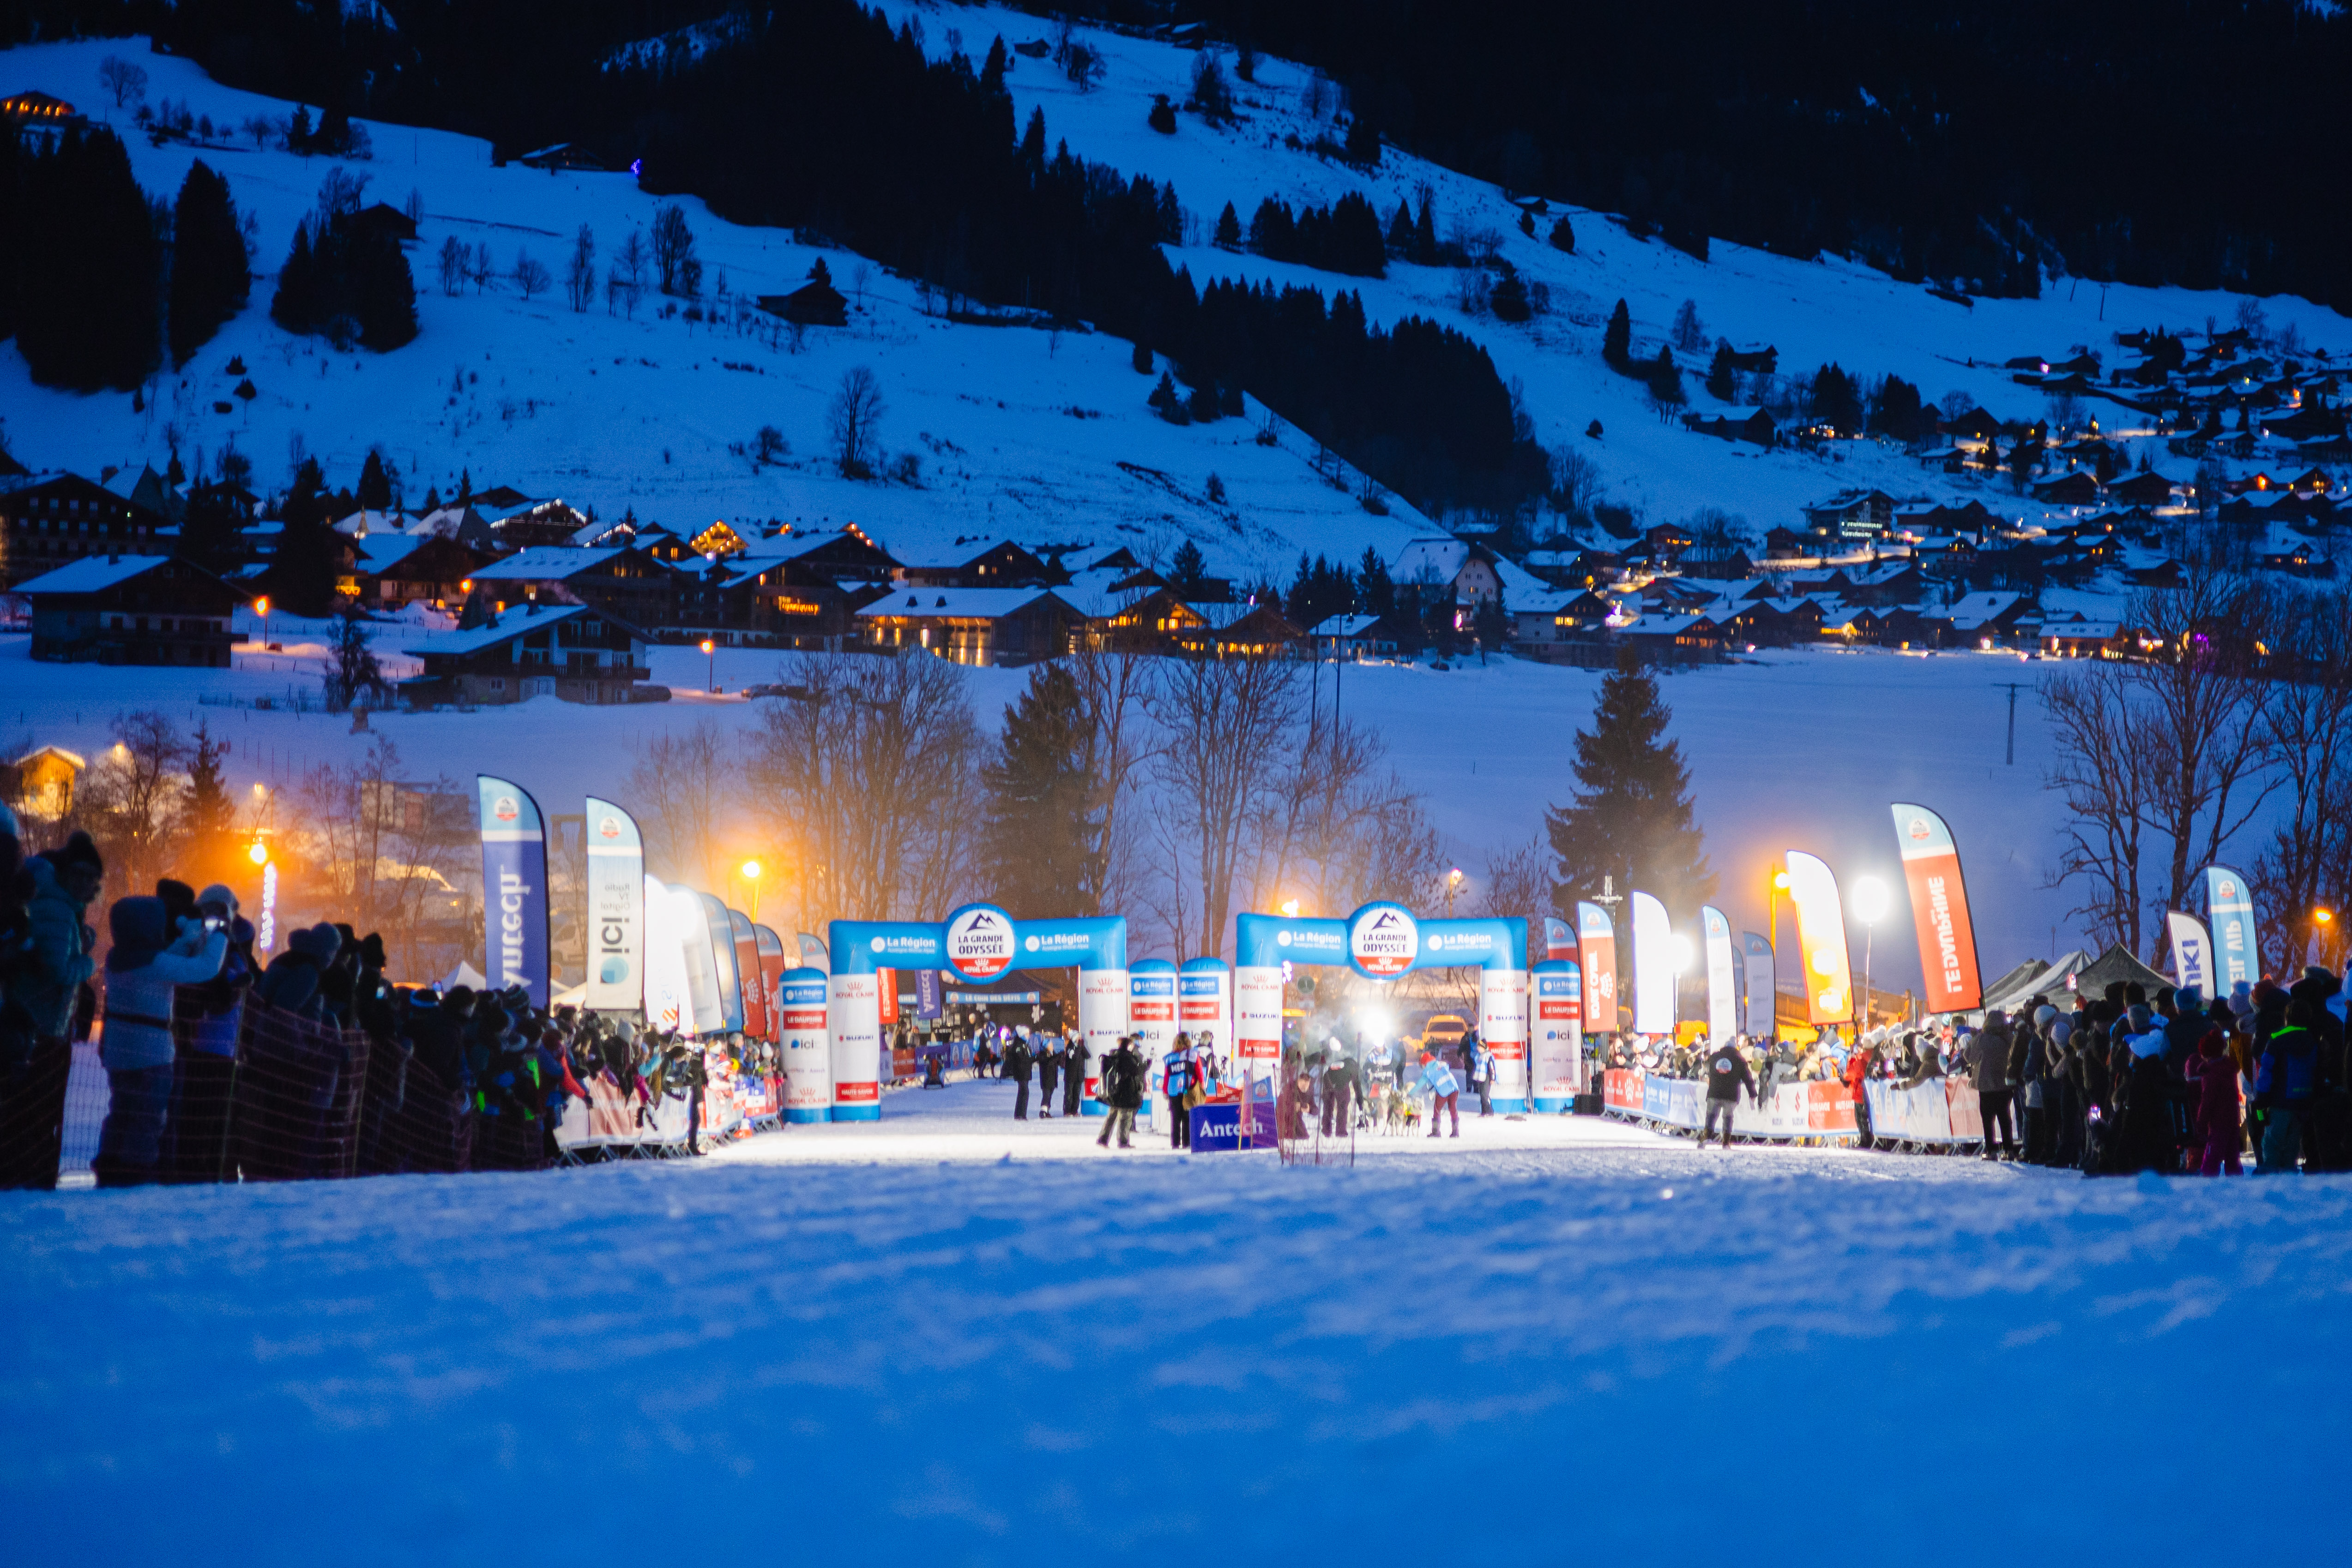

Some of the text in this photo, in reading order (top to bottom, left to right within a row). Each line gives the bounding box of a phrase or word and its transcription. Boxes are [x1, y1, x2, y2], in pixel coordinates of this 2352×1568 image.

[887, 936, 935, 949] La Région
[971, 934, 1004, 943] GRANDE
[1042, 934, 1089, 946] La Région
[1294, 931, 1340, 944] La Région
[1444, 933, 1491, 946] La Région
[959, 943, 1004, 954] ODYSSÉE
[1363, 943, 1407, 953] ODYSSÉE
[1150, 981, 1171, 990] Région
[1194, 980, 1215, 989] Région
[803, 989, 823, 998] Région
[1146, 1030, 1159, 1040] ici
[1557, 1030, 1570, 1041] ici
[801, 1038, 814, 1049] ici
[1772, 1117, 1783, 1126] SUZUKI
[1792, 1117, 1805, 1126] SUZUKI
[1200, 1117, 1263, 1138] Antech
